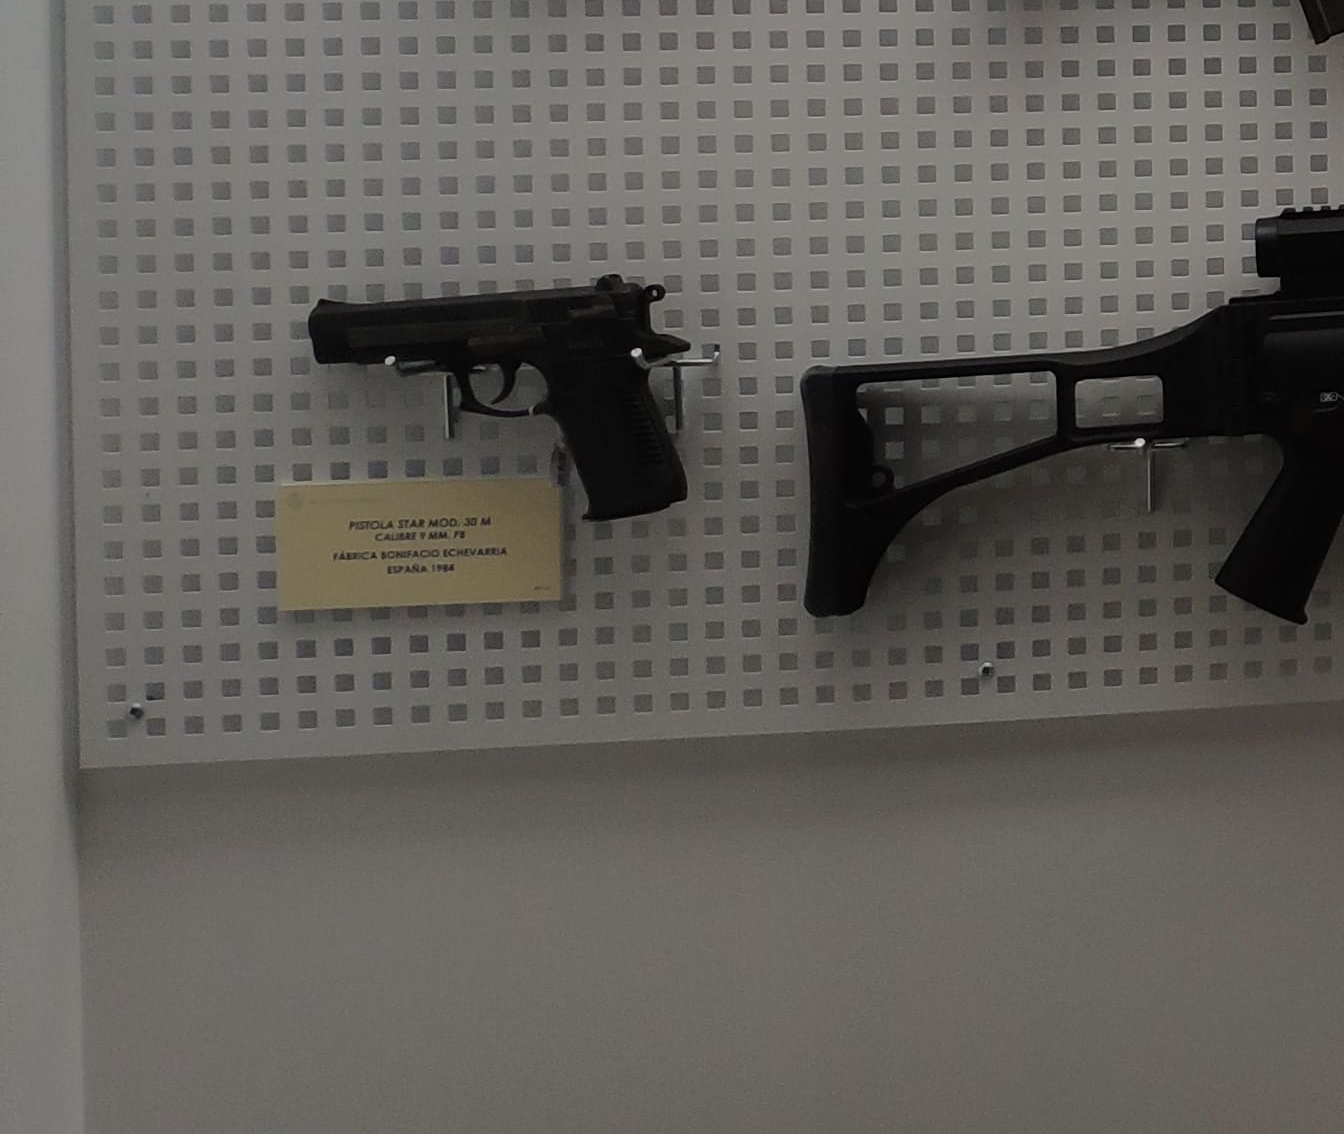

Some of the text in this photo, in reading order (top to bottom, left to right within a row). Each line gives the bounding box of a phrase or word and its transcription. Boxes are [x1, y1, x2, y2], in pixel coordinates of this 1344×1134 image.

[349, 520, 394, 530] PISTOLA
[398, 518, 426, 529] STAR
[481, 516, 492, 526] M
[375, 531, 417, 542] CALIBRE
[380, 549, 440, 560] BONIFACIO
[387, 563, 427, 575] ESPAÑA
